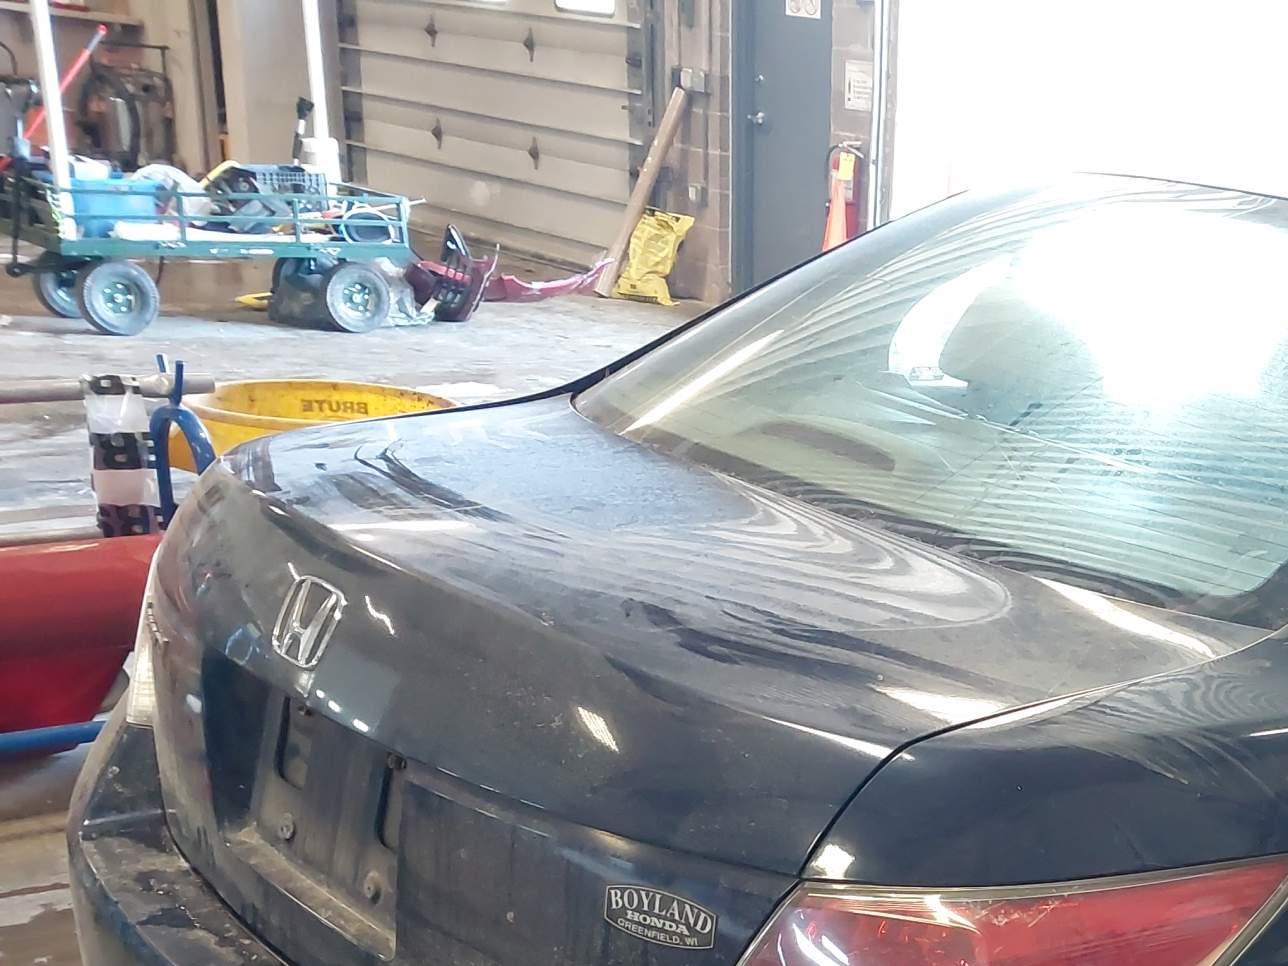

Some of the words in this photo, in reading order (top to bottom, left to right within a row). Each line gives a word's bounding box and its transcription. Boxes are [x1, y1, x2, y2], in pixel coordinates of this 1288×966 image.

[609, 889, 712, 934] BOYLAND
[626, 910, 691, 935] HONDA
[684, 936, 699, 947] WI
